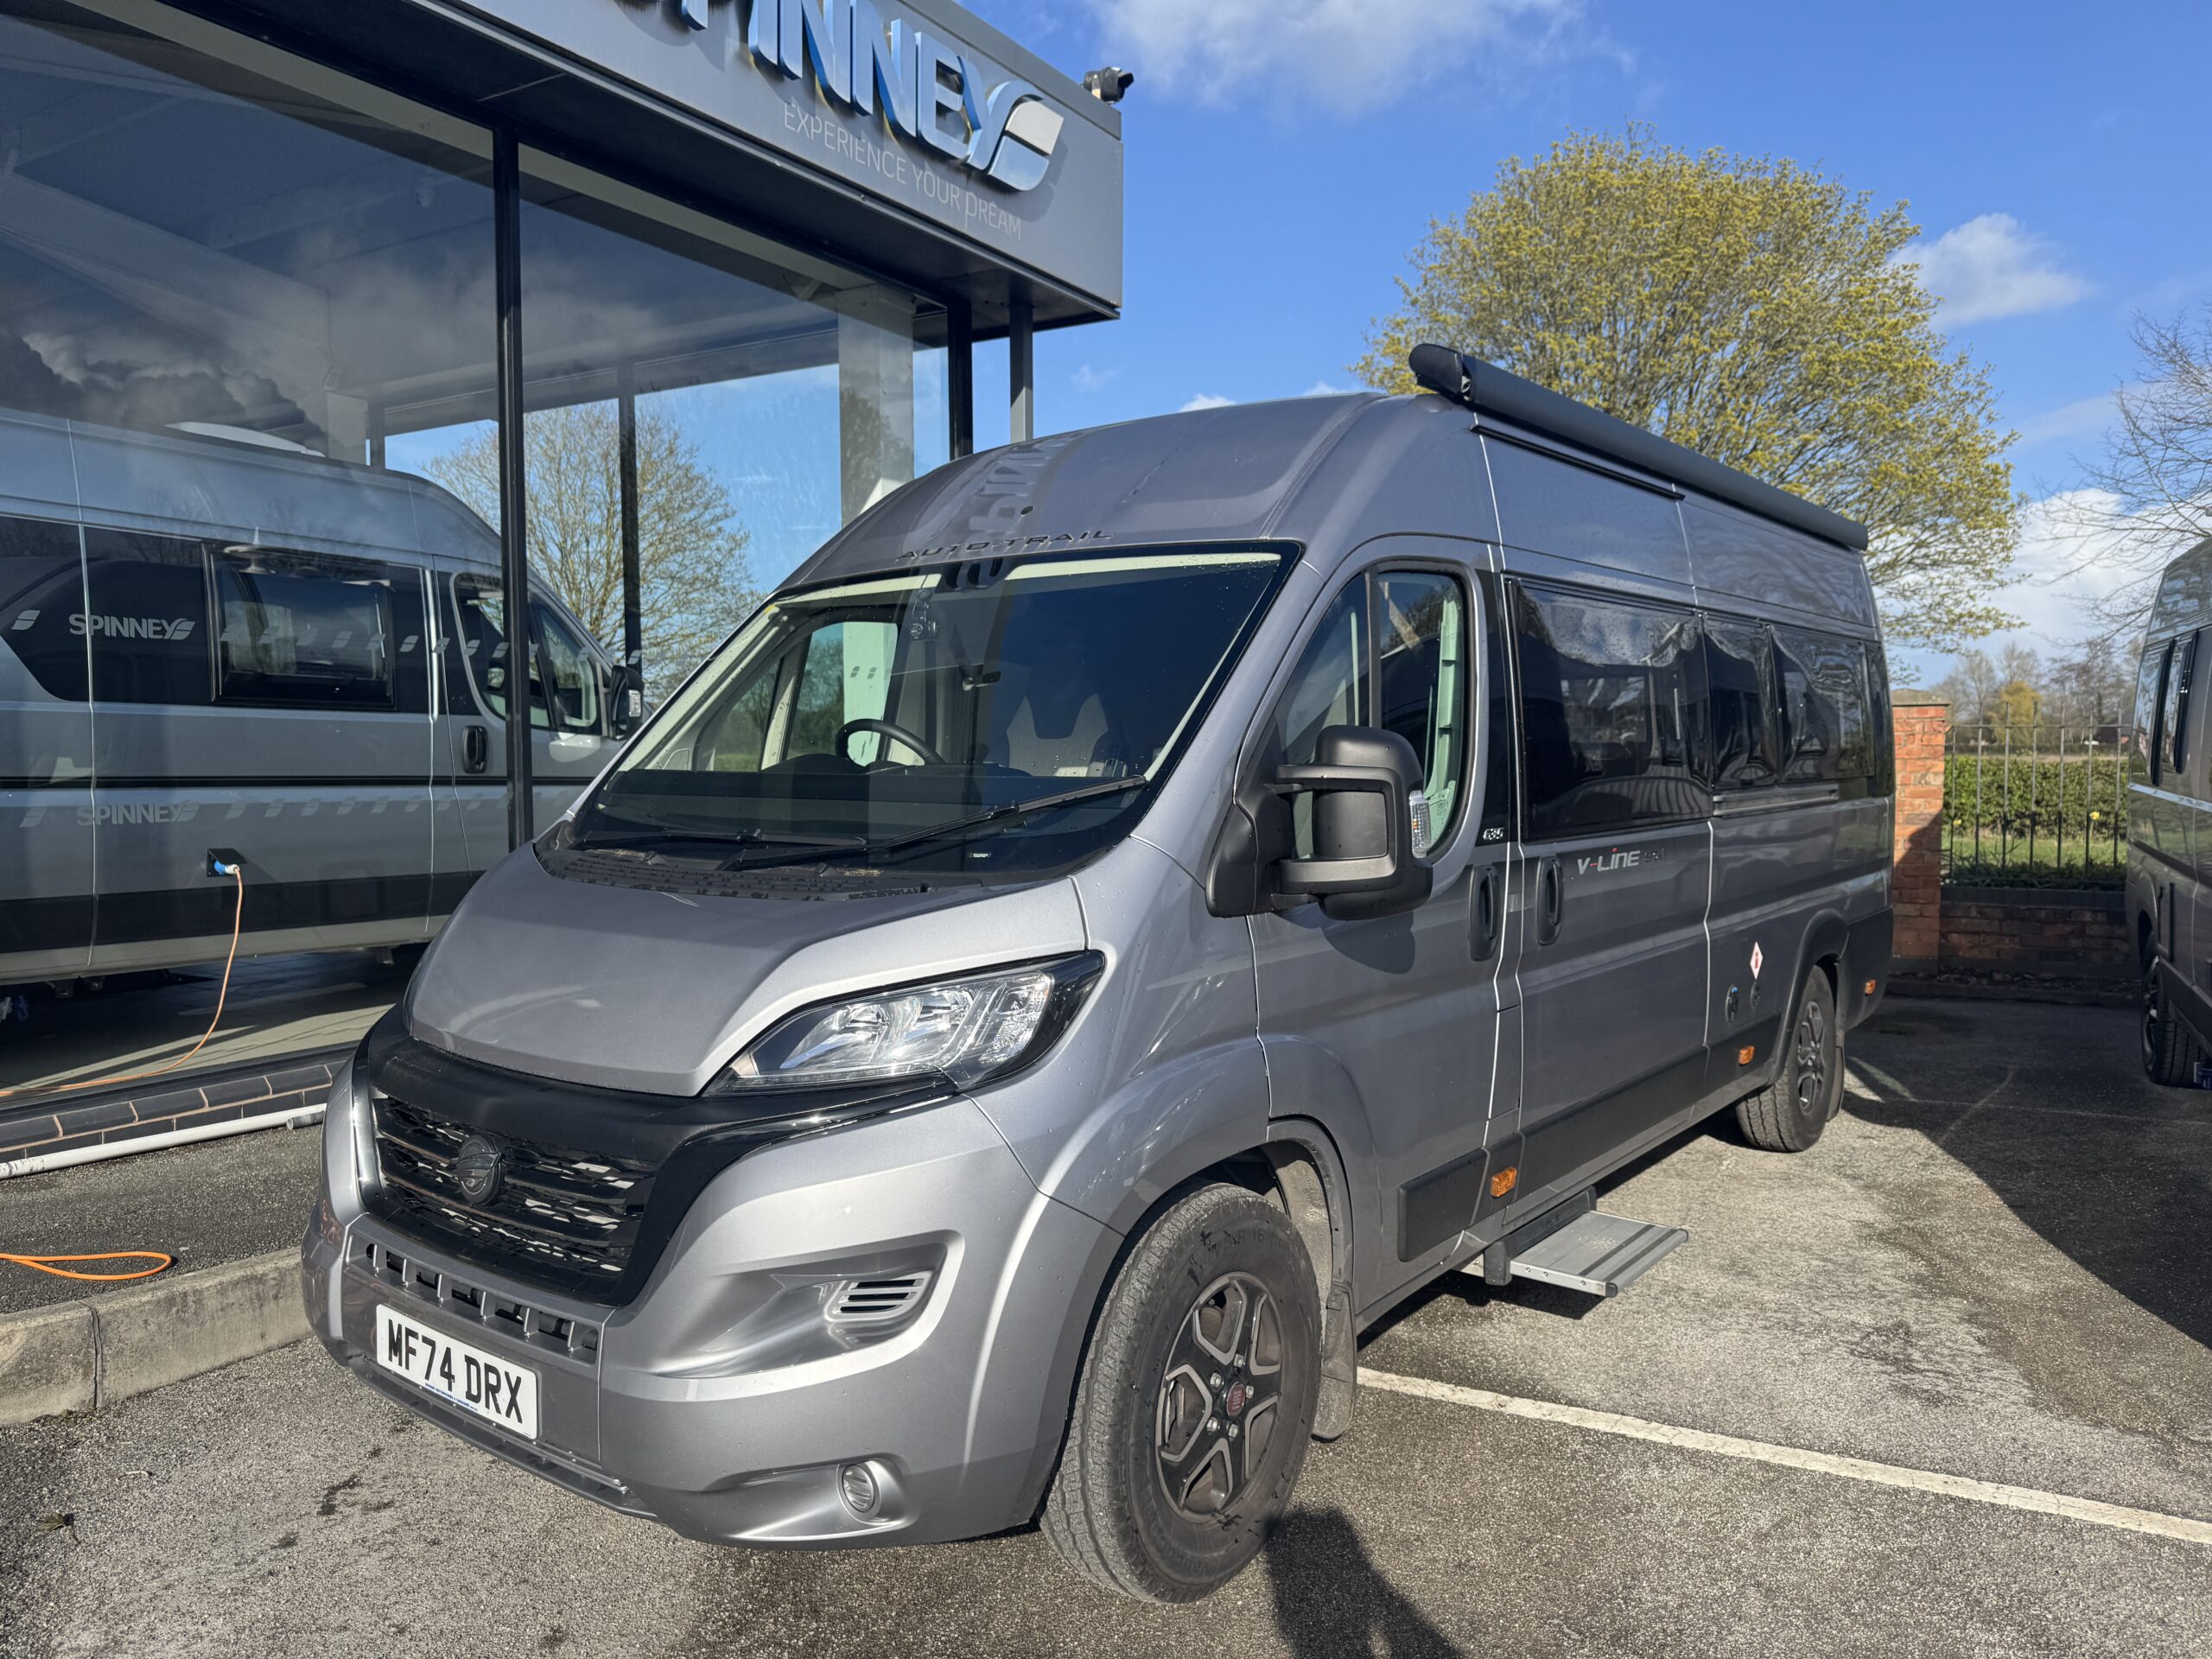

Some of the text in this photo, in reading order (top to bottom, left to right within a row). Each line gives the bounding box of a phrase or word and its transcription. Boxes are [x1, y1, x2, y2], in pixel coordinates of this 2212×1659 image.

[679, 0, 1045, 173] INNEY
[784, 100, 1022, 240] EXPERIENCE YOUR DREAM
[68, 613, 188, 640] SPINNEY
[76, 800, 192, 826] SPINNEY
[389, 1319, 456, 1393] MF74
[464, 1354, 523, 1425] DRX
